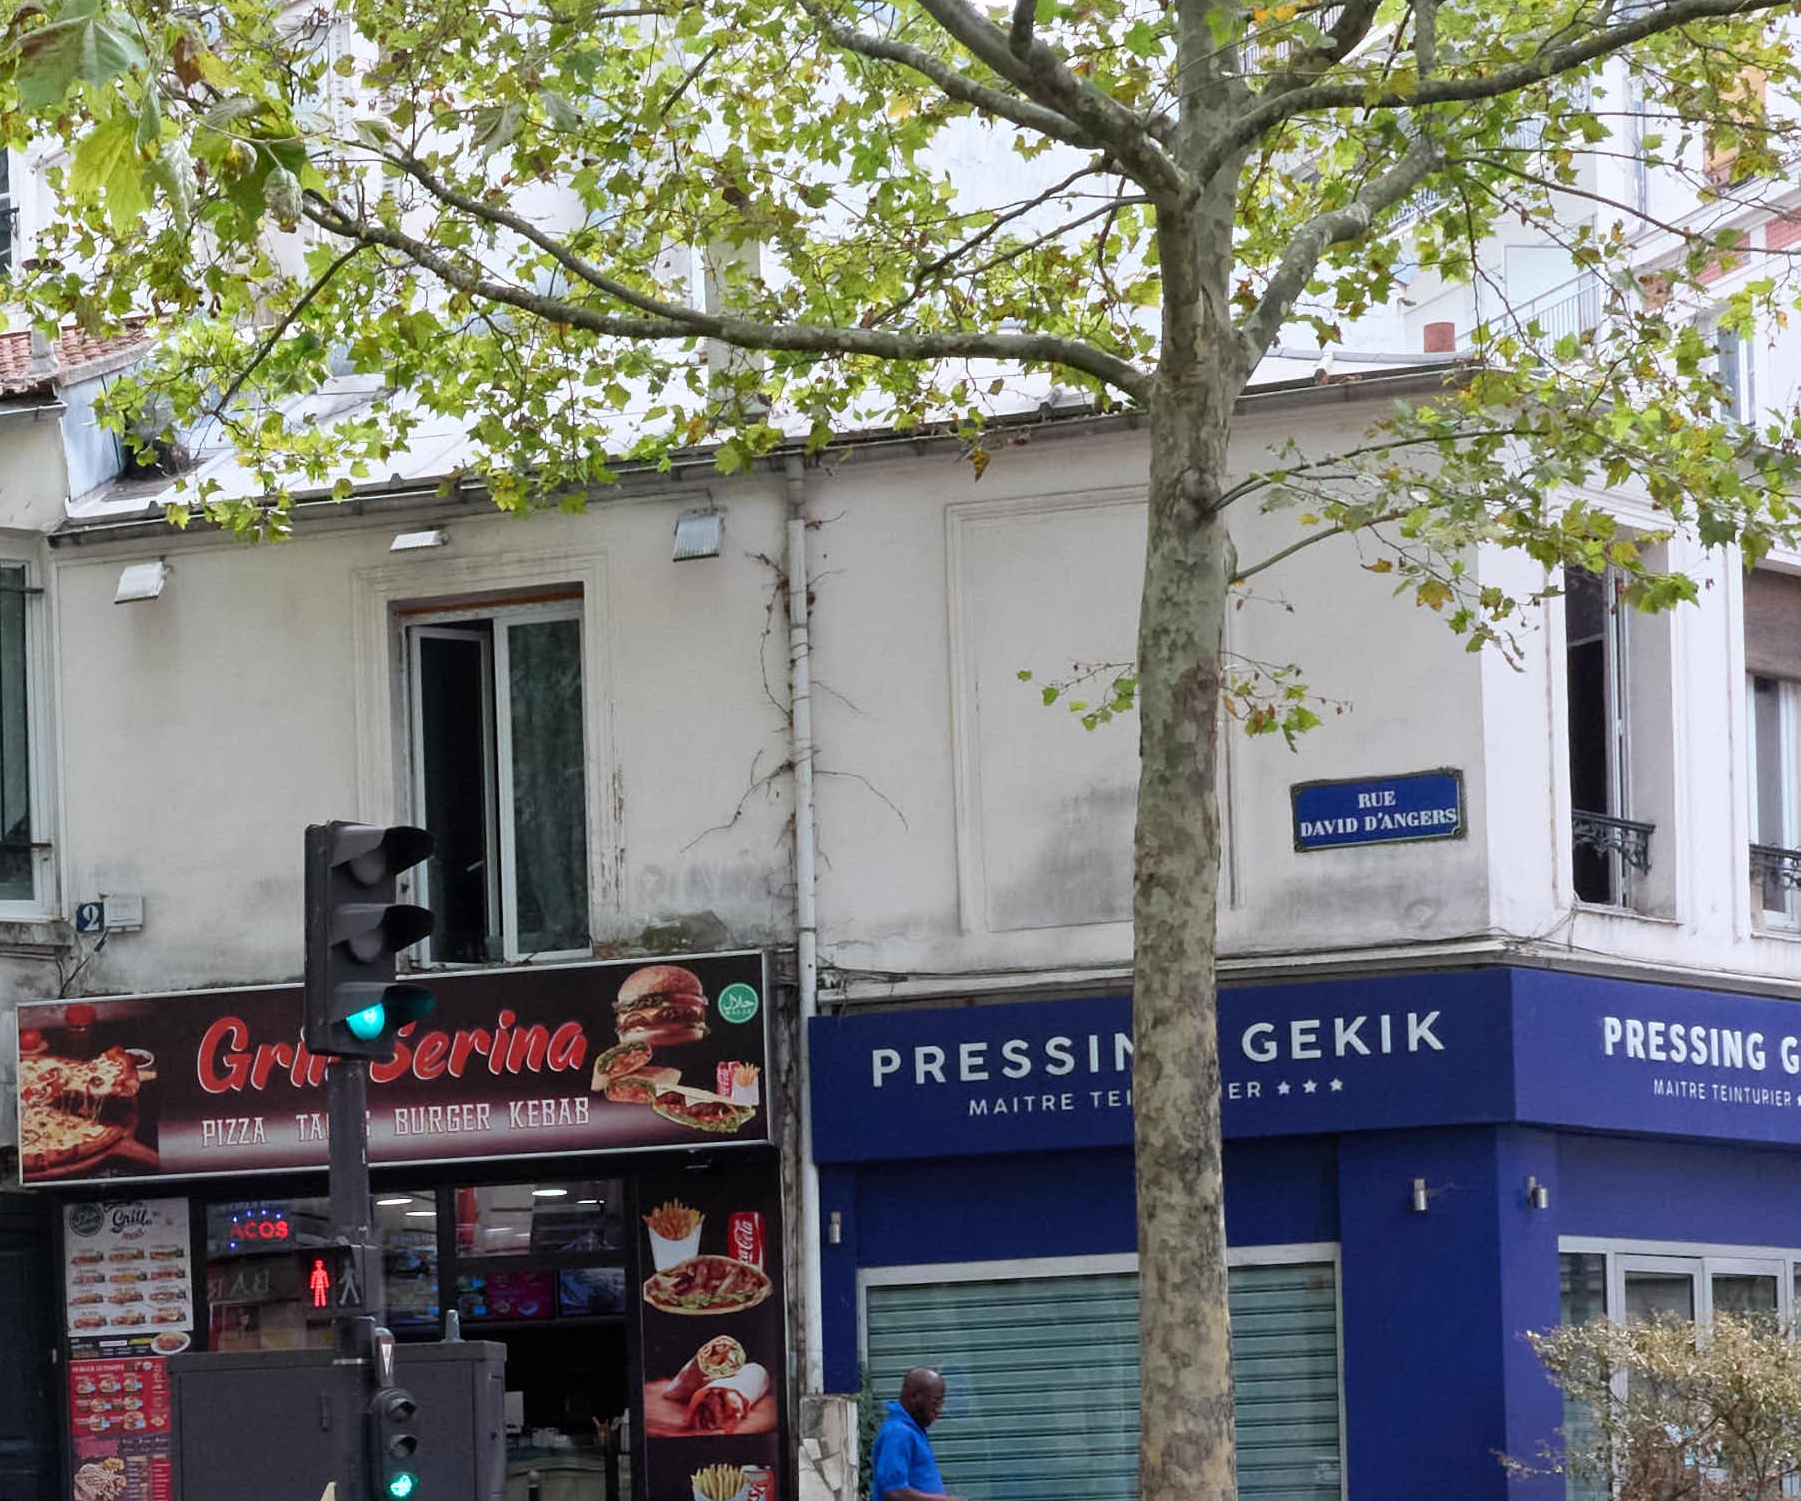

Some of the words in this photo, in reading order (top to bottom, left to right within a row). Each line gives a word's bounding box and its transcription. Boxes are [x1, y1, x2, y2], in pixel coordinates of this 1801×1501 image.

[1357, 790, 1397, 809] RUE
[1300, 817, 1358, 837] DAVID
[1364, 808, 1458, 832] D'ANGERS
[83, 904, 100, 932] 2
[872, 1032, 1136, 1088] PRESSIN
[1241, 1010, 1445, 1063] GEKIK
[1603, 1016, 1767, 1071] PRESSING
[1780, 1036, 1801, 1075] G
[968, 1091, 1074, 1117] MAITRE
[1654, 1078, 1706, 1100] MAITRE
[1711, 1084, 1792, 1107] TEINTURIER
[201, 1116, 267, 1148] PIZZA
[394, 1103, 492, 1136] BURGER
[509, 1096, 591, 1130] KEBAB
